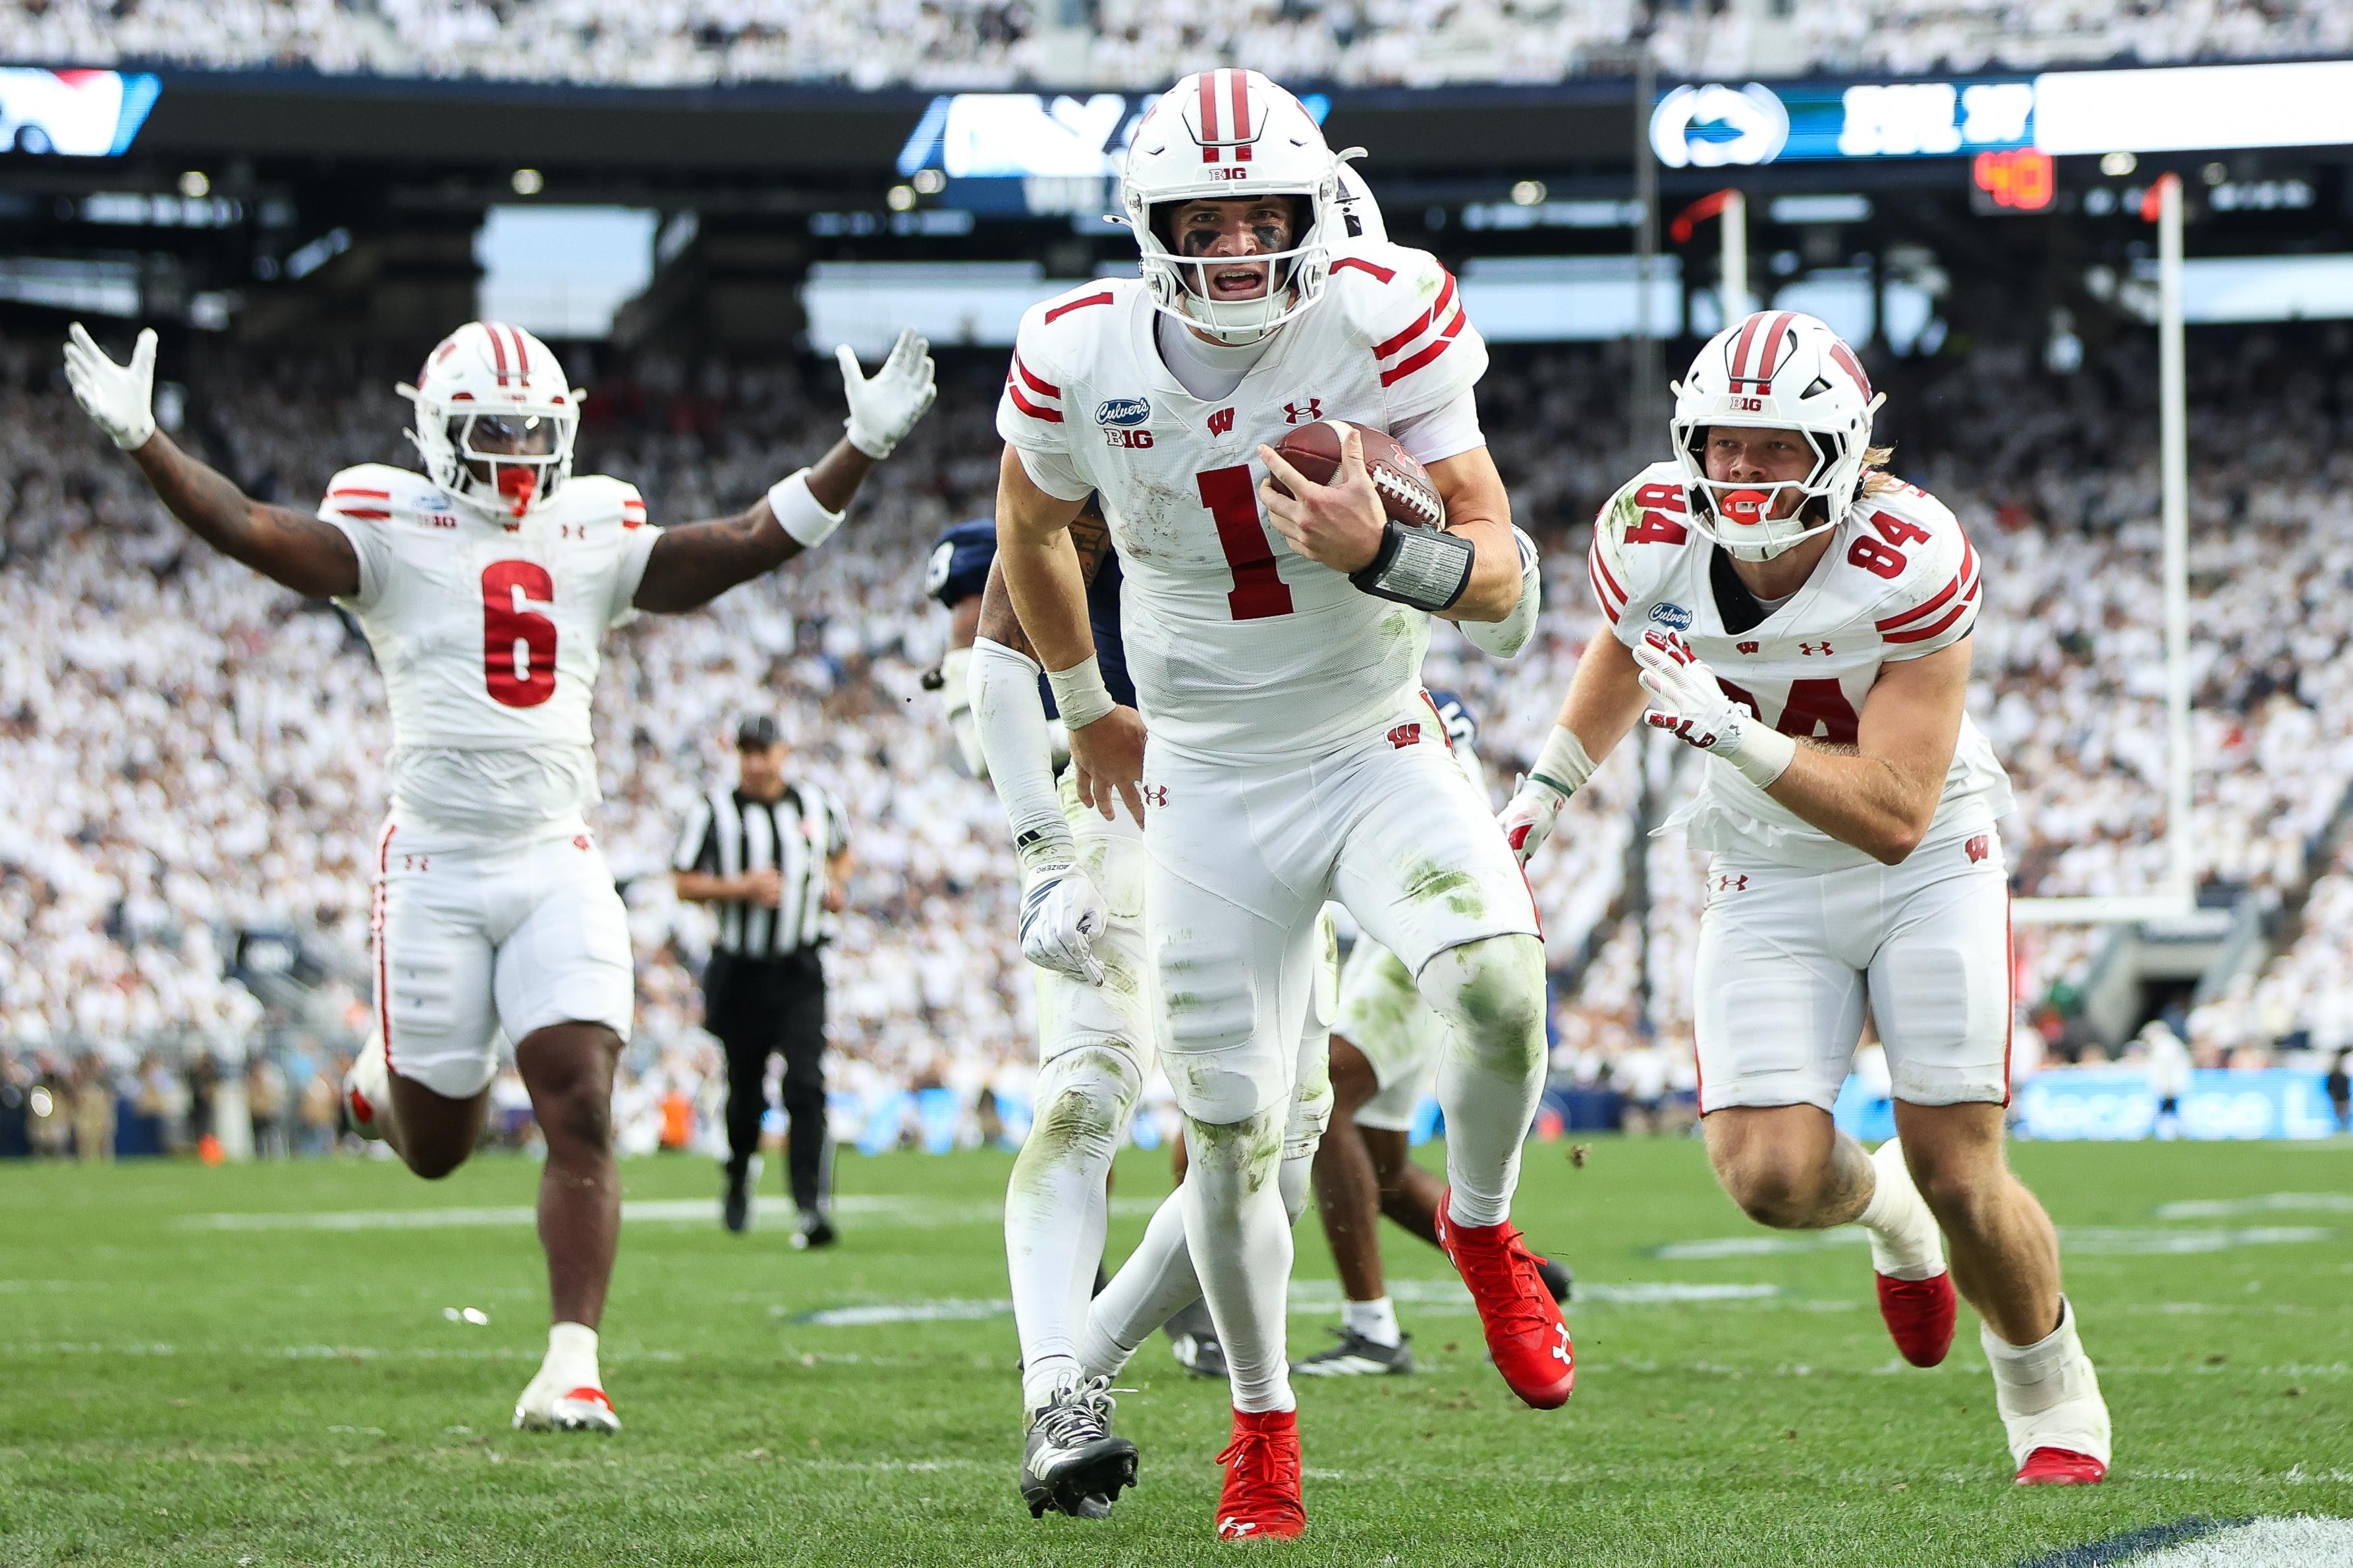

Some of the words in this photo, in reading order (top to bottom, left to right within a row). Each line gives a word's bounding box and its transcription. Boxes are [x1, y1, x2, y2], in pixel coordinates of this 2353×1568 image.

[1328, 257, 1397, 284] 1
[1045, 292, 1114, 325] 1
[1095, 398, 1150, 424] Culver's
[1207, 407, 1236, 439] W
[1623, 483, 1688, 546] 84
[1196, 463, 1295, 621] 1
[1847, 510, 1933, 580] 84
[1649, 603, 1692, 627] Culver's
[482, 560, 557, 709] 6
[1735, 641, 1759, 655] W
[1715, 677, 1860, 747] 4
[1387, 723, 1420, 750] W
[1964, 834, 1988, 865] W
[1036, 864, 1070, 873] ADIZERO
